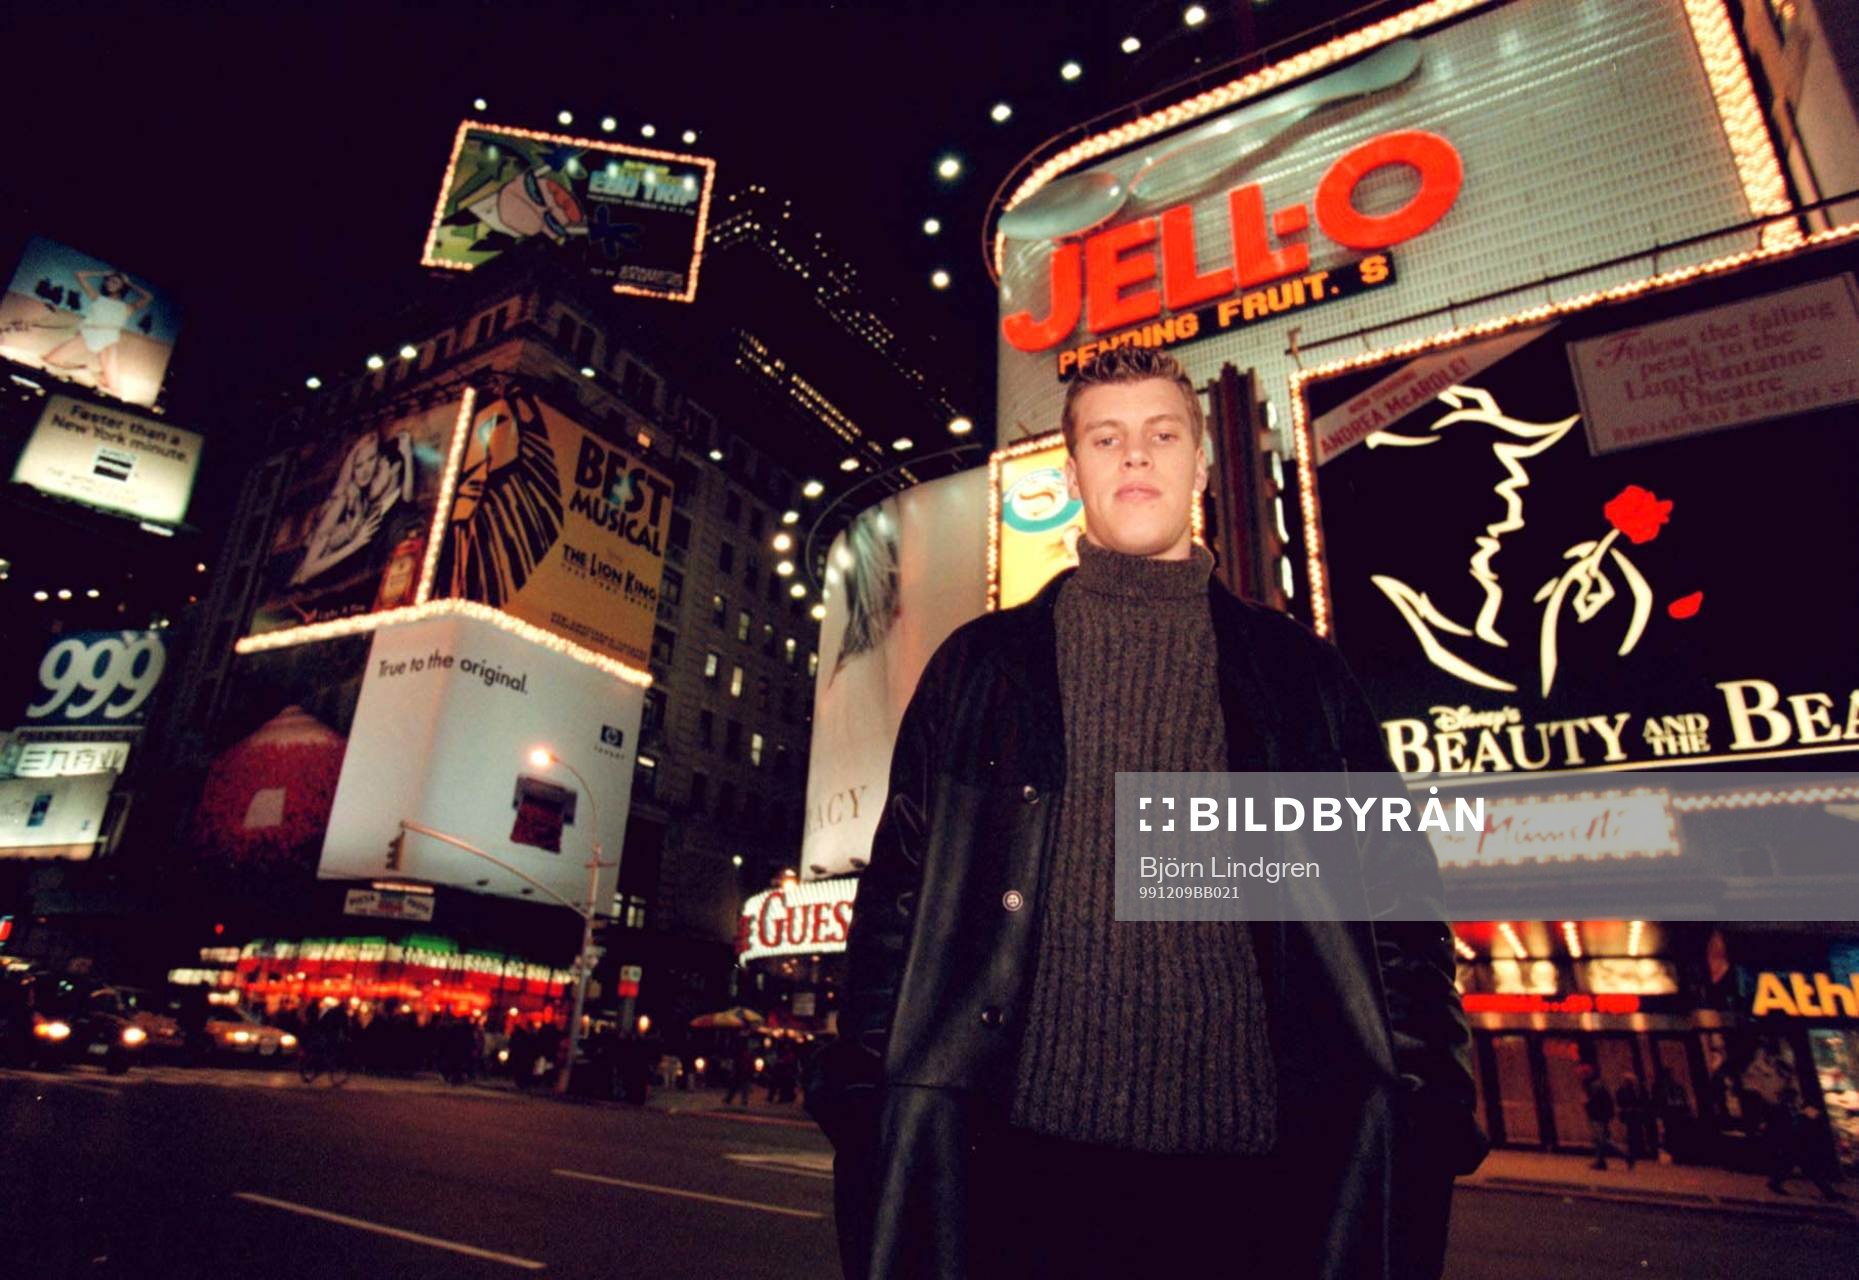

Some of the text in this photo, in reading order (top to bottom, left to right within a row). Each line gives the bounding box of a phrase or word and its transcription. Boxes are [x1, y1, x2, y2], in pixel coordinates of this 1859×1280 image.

[1003, 129, 1464, 353] JELL-O
[1059, 256, 1389, 376] PENDING FRUIT. S
[51, 413, 88, 434] New
[93, 426, 126, 447] York
[69, 403, 124, 430] Faster
[129, 422, 167, 443] than
[574, 434, 673, 529] BEST
[563, 543, 587, 567] THE
[568, 489, 662, 558] MUSICAL
[26, 637, 166, 719] 999
[378, 659, 407, 678] True
[409, 656, 425, 672] to
[427, 649, 454, 671] the
[1381, 712, 1710, 781] BEAUTY AND
[1646, 733, 1712, 757] THE
